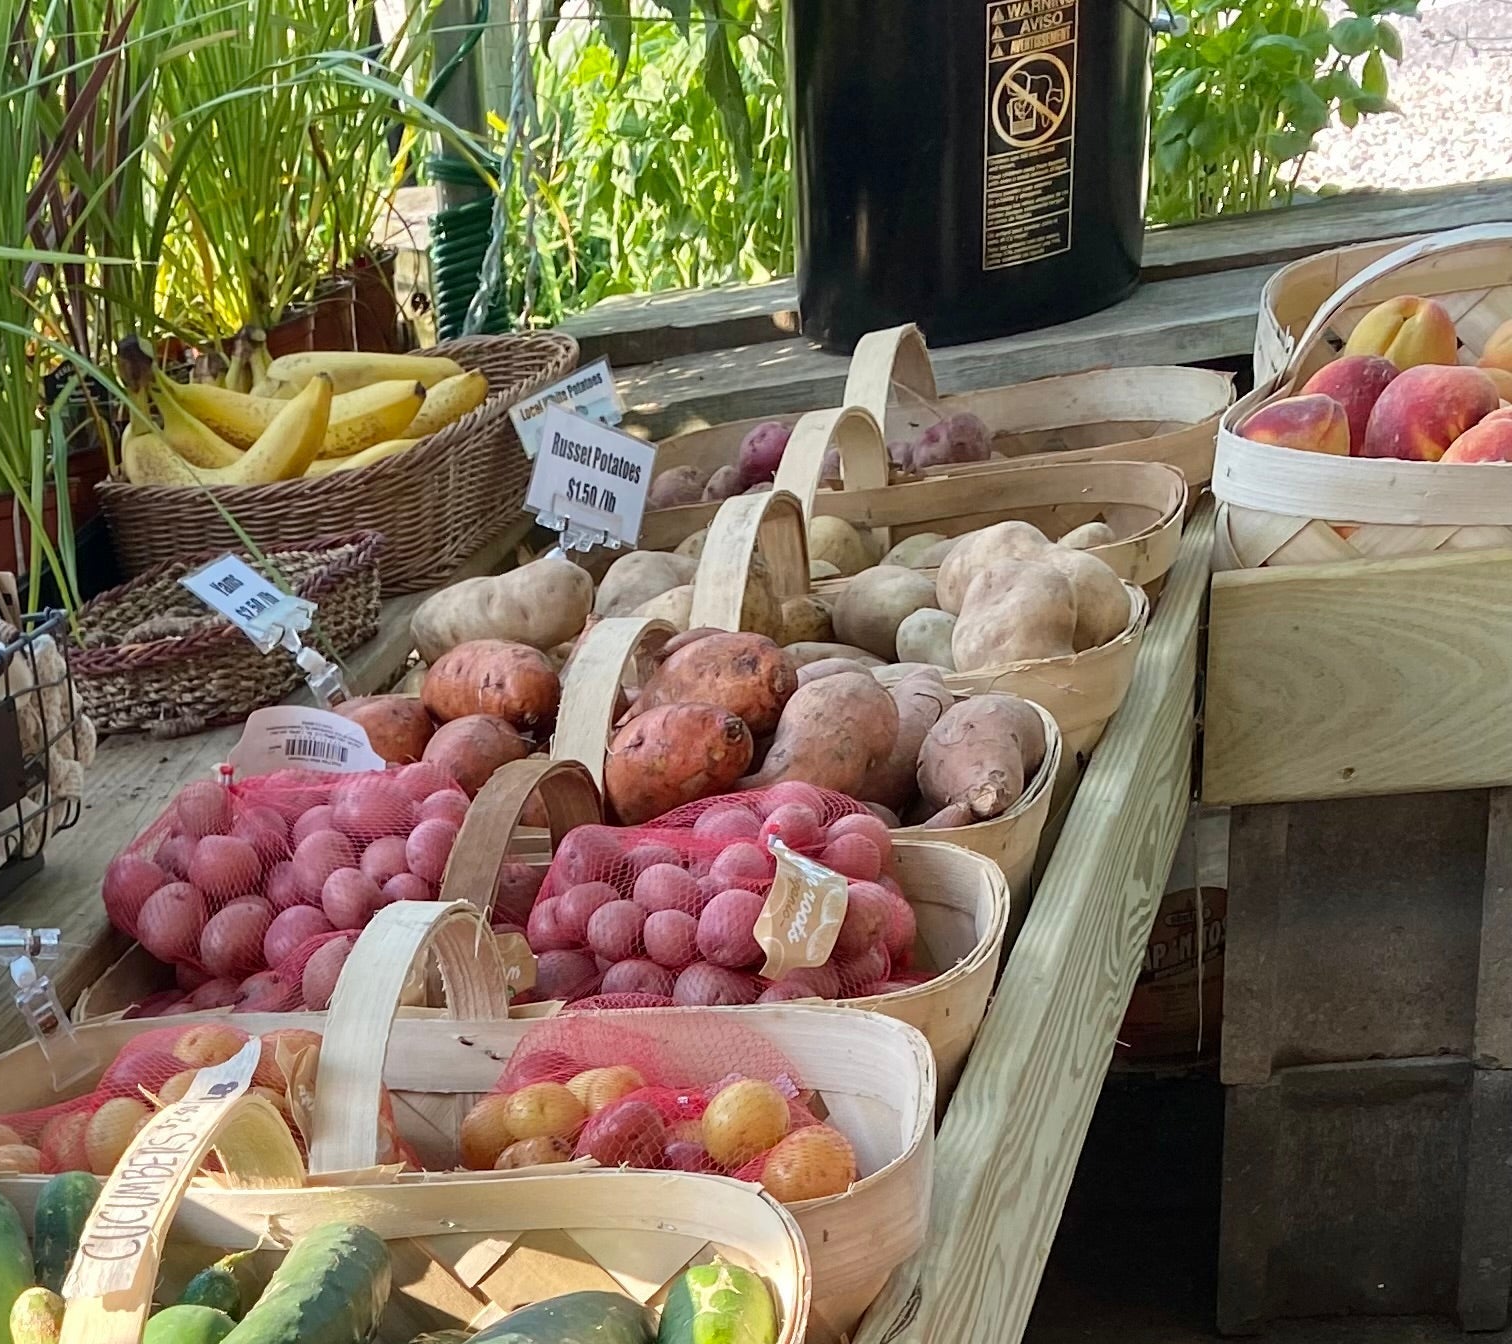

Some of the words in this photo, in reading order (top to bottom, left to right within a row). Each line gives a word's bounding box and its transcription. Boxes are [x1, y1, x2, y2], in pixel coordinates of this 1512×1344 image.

[1020, 11, 1063, 34] AVISO
[520, 404, 544, 421] Local
[567, 372, 603, 399] Potatoes
[551, 432, 591, 467] Russet
[592, 447, 641, 485] Potatoes
[209, 574, 244, 597] Yams
[788, 889, 816, 944] roots
